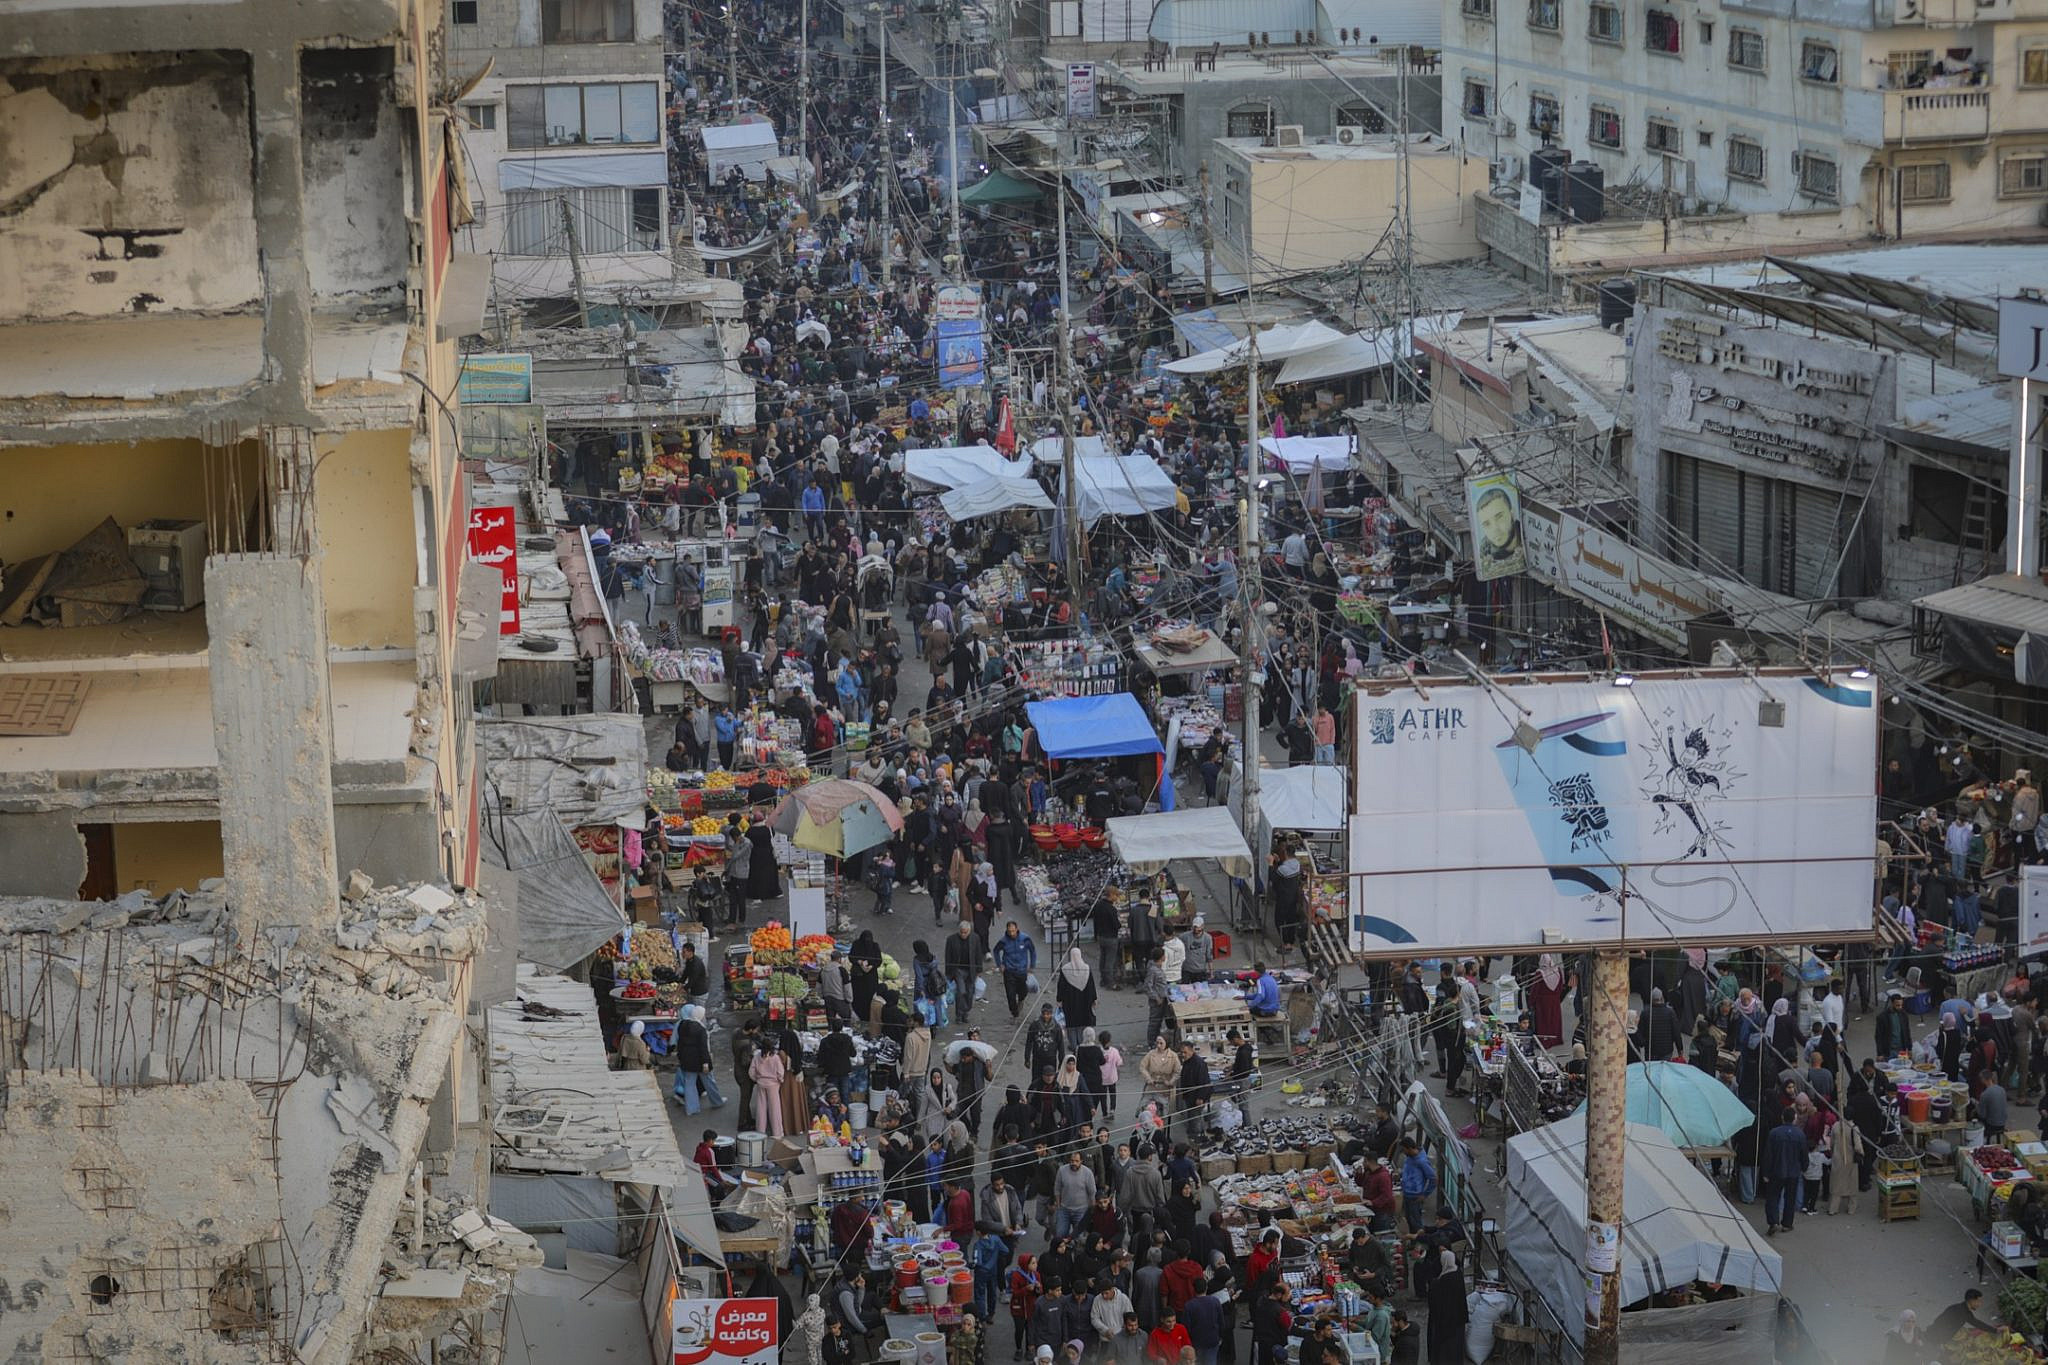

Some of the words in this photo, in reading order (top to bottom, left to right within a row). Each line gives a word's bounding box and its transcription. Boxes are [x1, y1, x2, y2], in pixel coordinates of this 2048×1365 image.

[2029, 326, 2048, 373] J
[468, 512, 505, 533] مرك
[467, 540, 514, 564] حسا
[1398, 707, 1467, 730] ATHR
[1408, 730, 1457, 742] CAFE
[1570, 829, 1614, 854] ATHR
[721, 1309, 768, 1327] معرض
[719, 1328, 770, 1344] وكافيه
